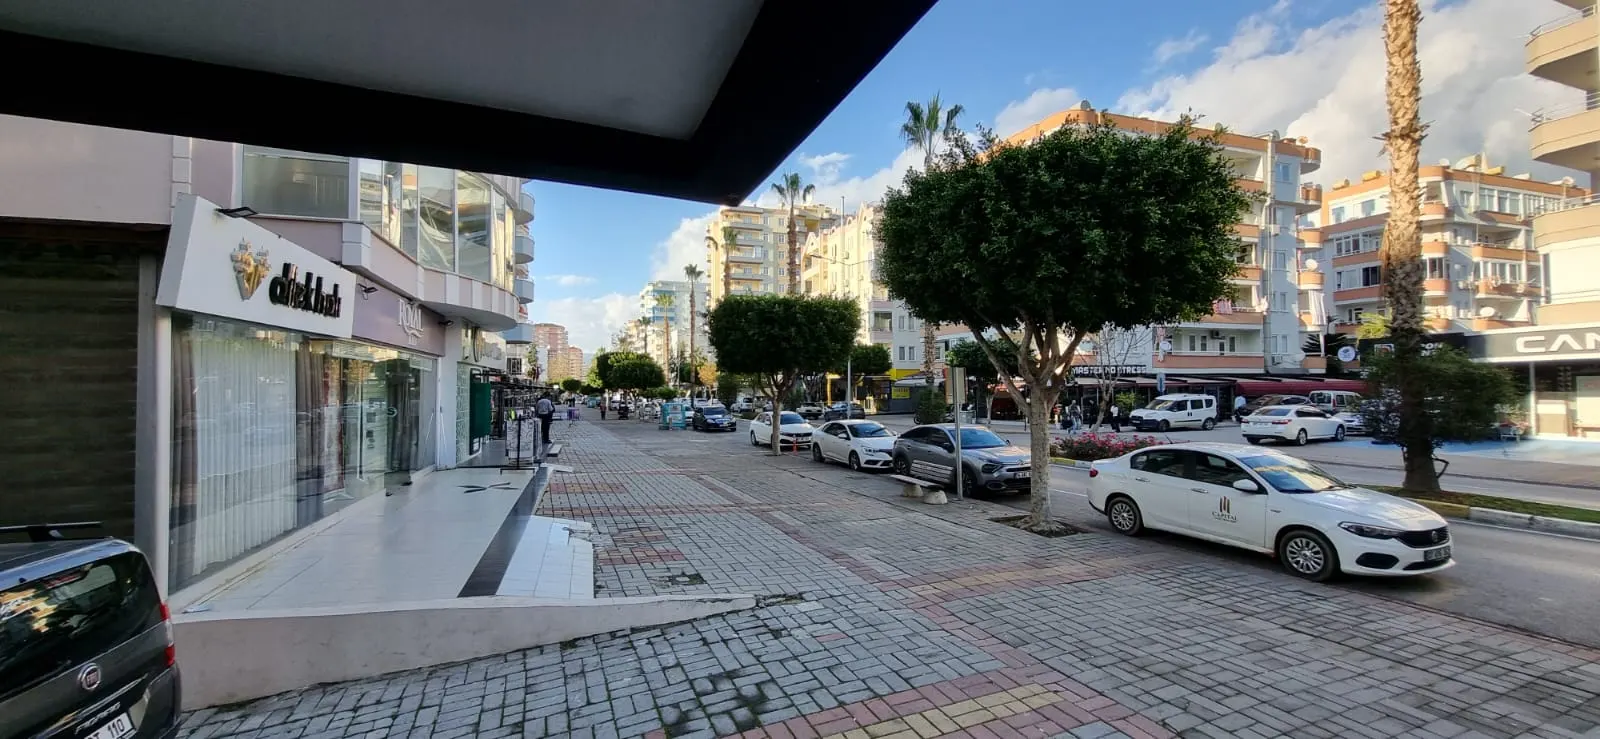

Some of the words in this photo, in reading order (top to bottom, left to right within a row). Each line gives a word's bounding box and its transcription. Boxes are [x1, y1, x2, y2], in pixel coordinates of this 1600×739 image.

[398, 298, 424, 338] ROYAL
[1105, 366, 1116, 374] NO
[107, 719, 126, 739] 110
